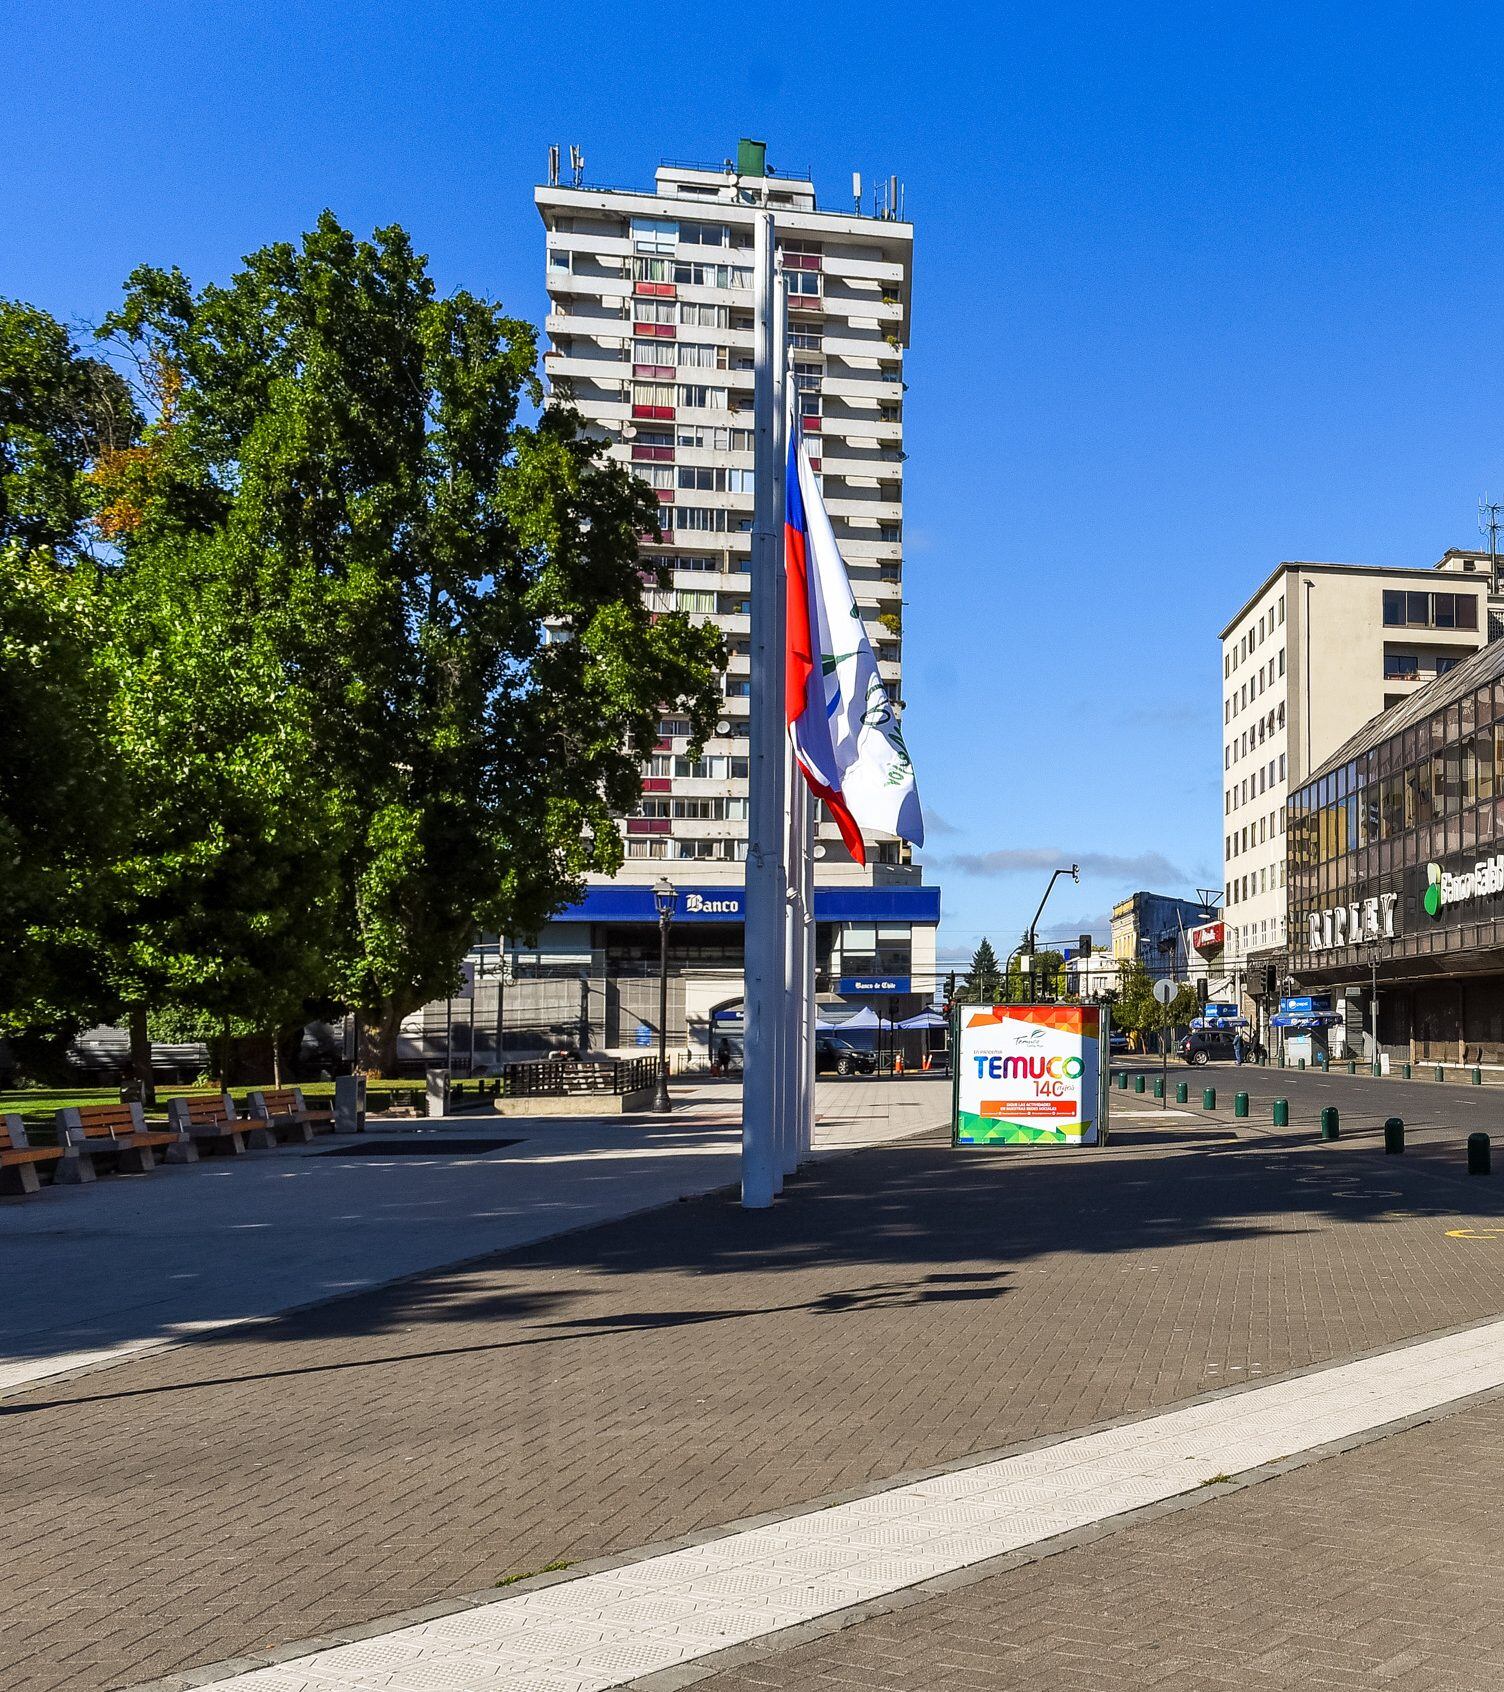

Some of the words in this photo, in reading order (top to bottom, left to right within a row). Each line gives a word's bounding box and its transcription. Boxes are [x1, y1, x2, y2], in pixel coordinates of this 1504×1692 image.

[1440, 873, 1475, 905] Banco
[685, 894, 739, 913] Banco
[1308, 892, 1398, 952] RIPLEY
[973, 1055, 1085, 1079] TEMUCO
[1033, 1080, 1063, 1097] 140
